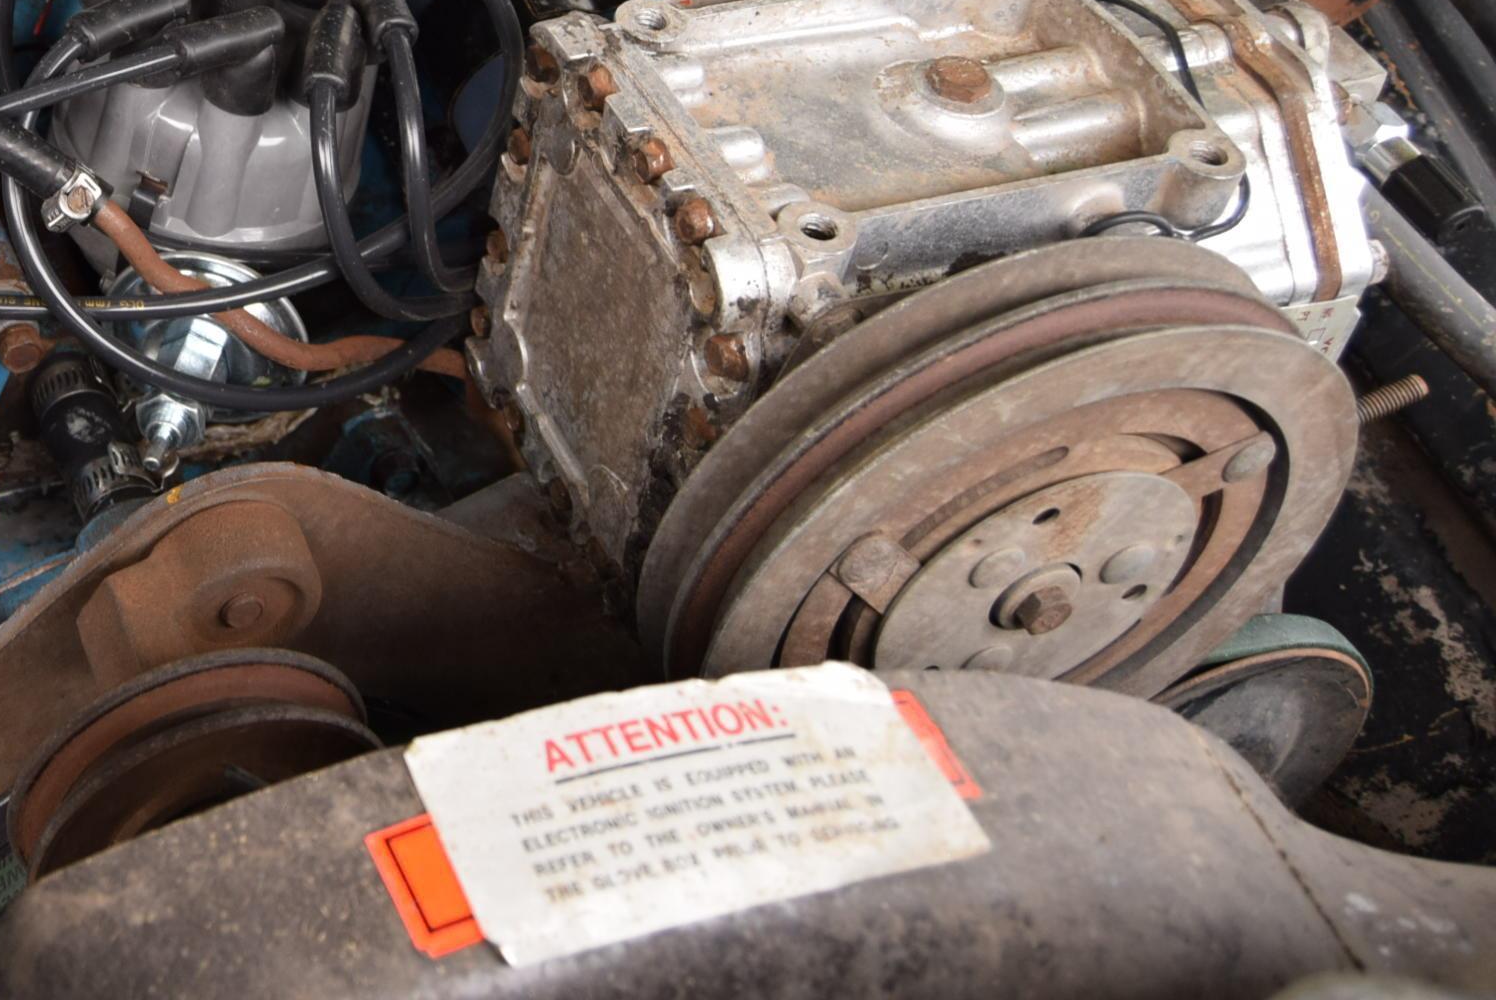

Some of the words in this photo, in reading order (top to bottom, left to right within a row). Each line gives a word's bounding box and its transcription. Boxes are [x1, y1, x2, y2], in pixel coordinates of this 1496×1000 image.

[542, 699, 788, 773] ATTENTION:
[510, 804, 554, 828] THIS
[568, 783, 643, 813] VEHICLE
[654, 777, 672, 791] IS
[685, 759, 769, 786] EQUIPPED
[783, 751, 822, 768] WITH
[834, 746, 856, 760] AN
[521, 812, 638, 853] ELECTRONIC
[645, 793, 724, 819] IGNITION
[809, 768, 870, 788] PLEASE
[532, 850, 596, 877] REFER
[608, 840, 633, 855] TO
[645, 828, 680, 848] THE
[544, 881, 584, 903] THE
